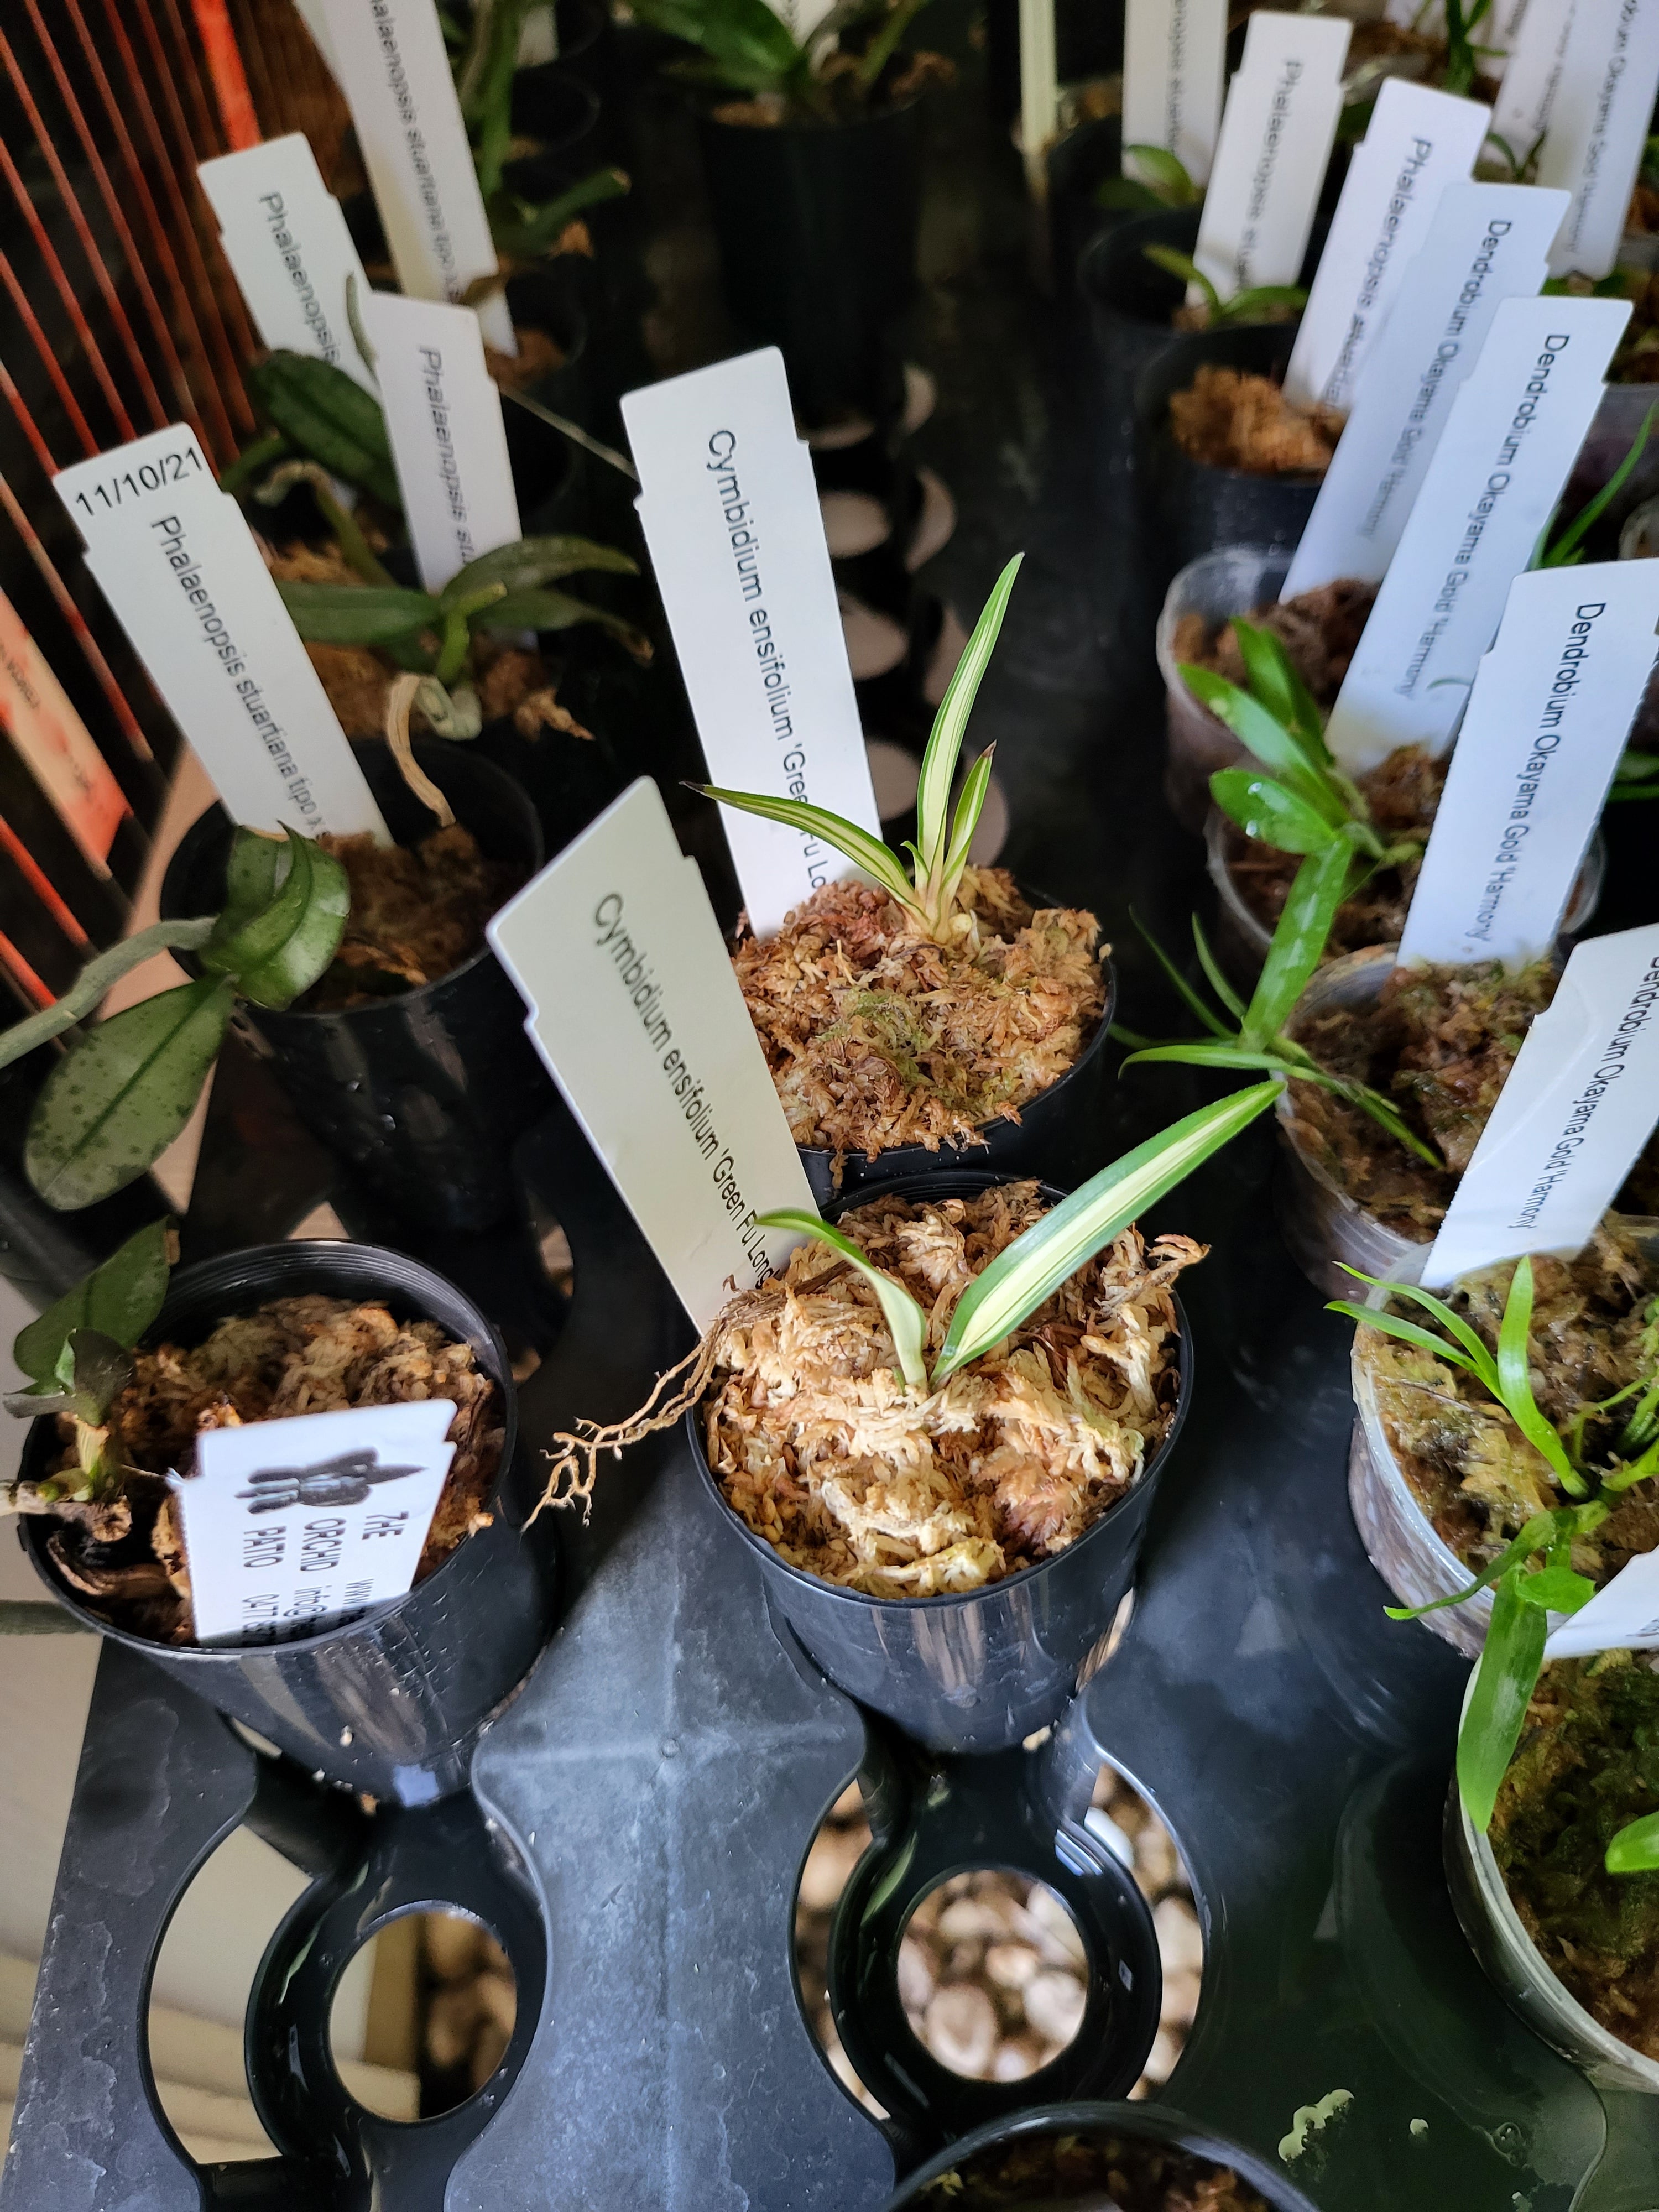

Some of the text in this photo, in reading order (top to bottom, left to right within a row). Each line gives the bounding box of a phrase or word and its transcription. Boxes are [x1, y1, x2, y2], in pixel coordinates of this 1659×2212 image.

[258, 191, 341, 362] Phalaenopsis
[1444, 220, 1512, 336] Dendrobium
[1496, 334, 1571, 466] Dendrobium
[75, 447, 204, 516] 11/10/21
[1453, 473, 1511, 566] Okayama
[150, 515, 248, 677] Phalaenopsis
[236, 678, 299, 780] stuartiana
[706, 429, 828, 889] Cymbidium ensifolium 'Gree u Lo
[1538, 602, 1606, 729] Dendrobium
[1509, 734, 1561, 820] Okayama
[1494, 824, 1530, 864] Gold
[594, 893, 673, 1052] Cymbidium
[663, 1048, 719, 1161] ensifolium
[713, 1147, 746, 1222] 'Green
[735, 1209, 758, 1246] Fu
[1562, 1063, 1625, 1136] Okayama
[1543, 1136, 1584, 1170] Gold
[1507, 1168, 1568, 1229] 'Harmony'
[243, 1525, 287, 1568] PATIO
[300, 1517, 347, 1572] ORCHID
[362, 1510, 409, 1540] THE
[242, 1593, 280, 1619] 0477
